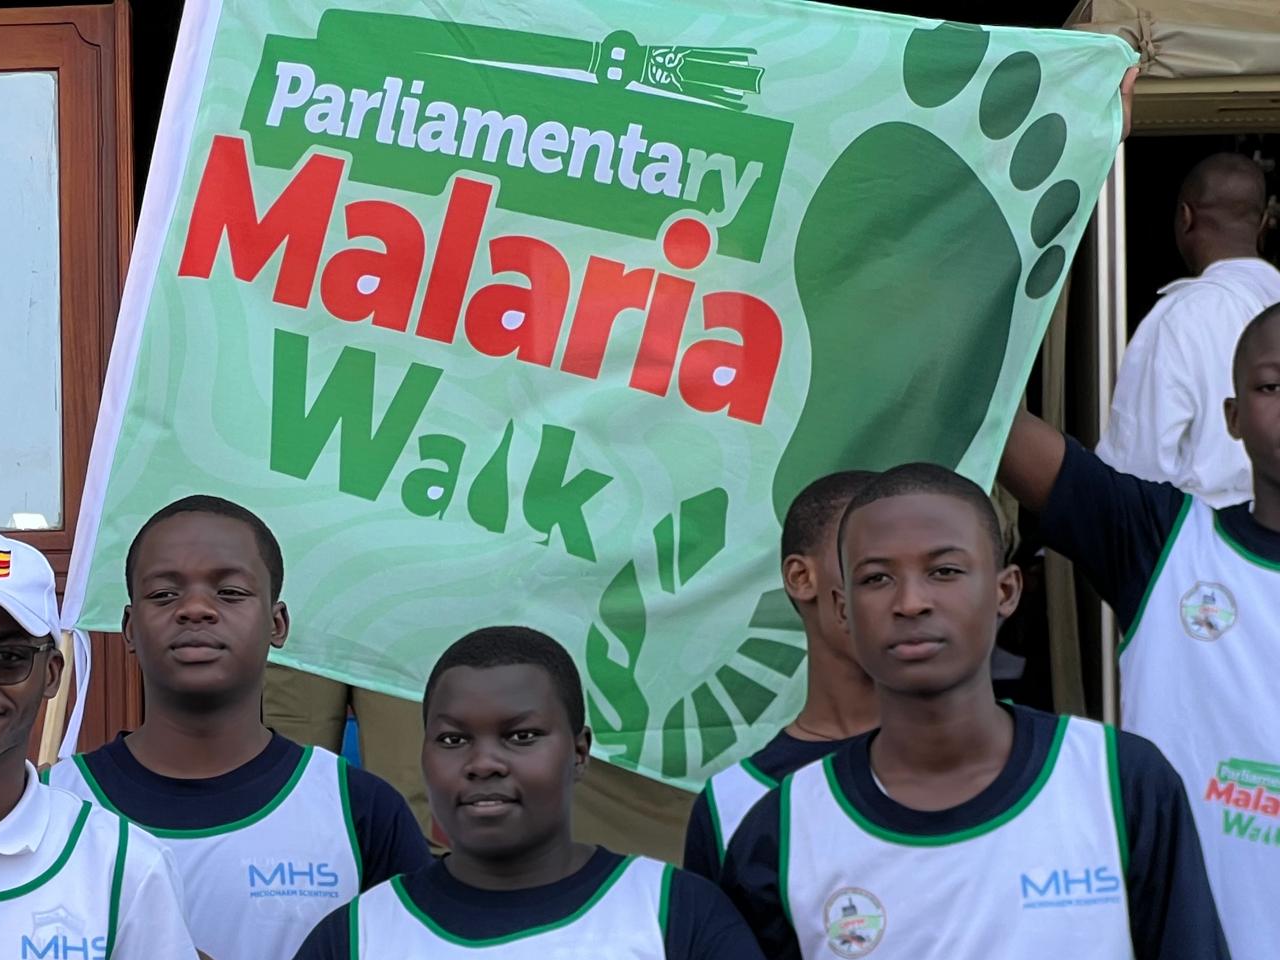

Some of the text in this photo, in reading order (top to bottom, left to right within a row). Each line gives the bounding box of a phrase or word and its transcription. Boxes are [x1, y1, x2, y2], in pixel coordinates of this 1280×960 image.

[265, 61, 763, 215] Parliamentary
[178, 134, 783, 425] Malaria
[270, 328, 614, 563] Walk
[1205, 778, 1280, 816] Mala
[248, 862, 339, 887] MHS
[1020, 866, 1120, 898] MHS
[21, 935, 107, 960] MHS
